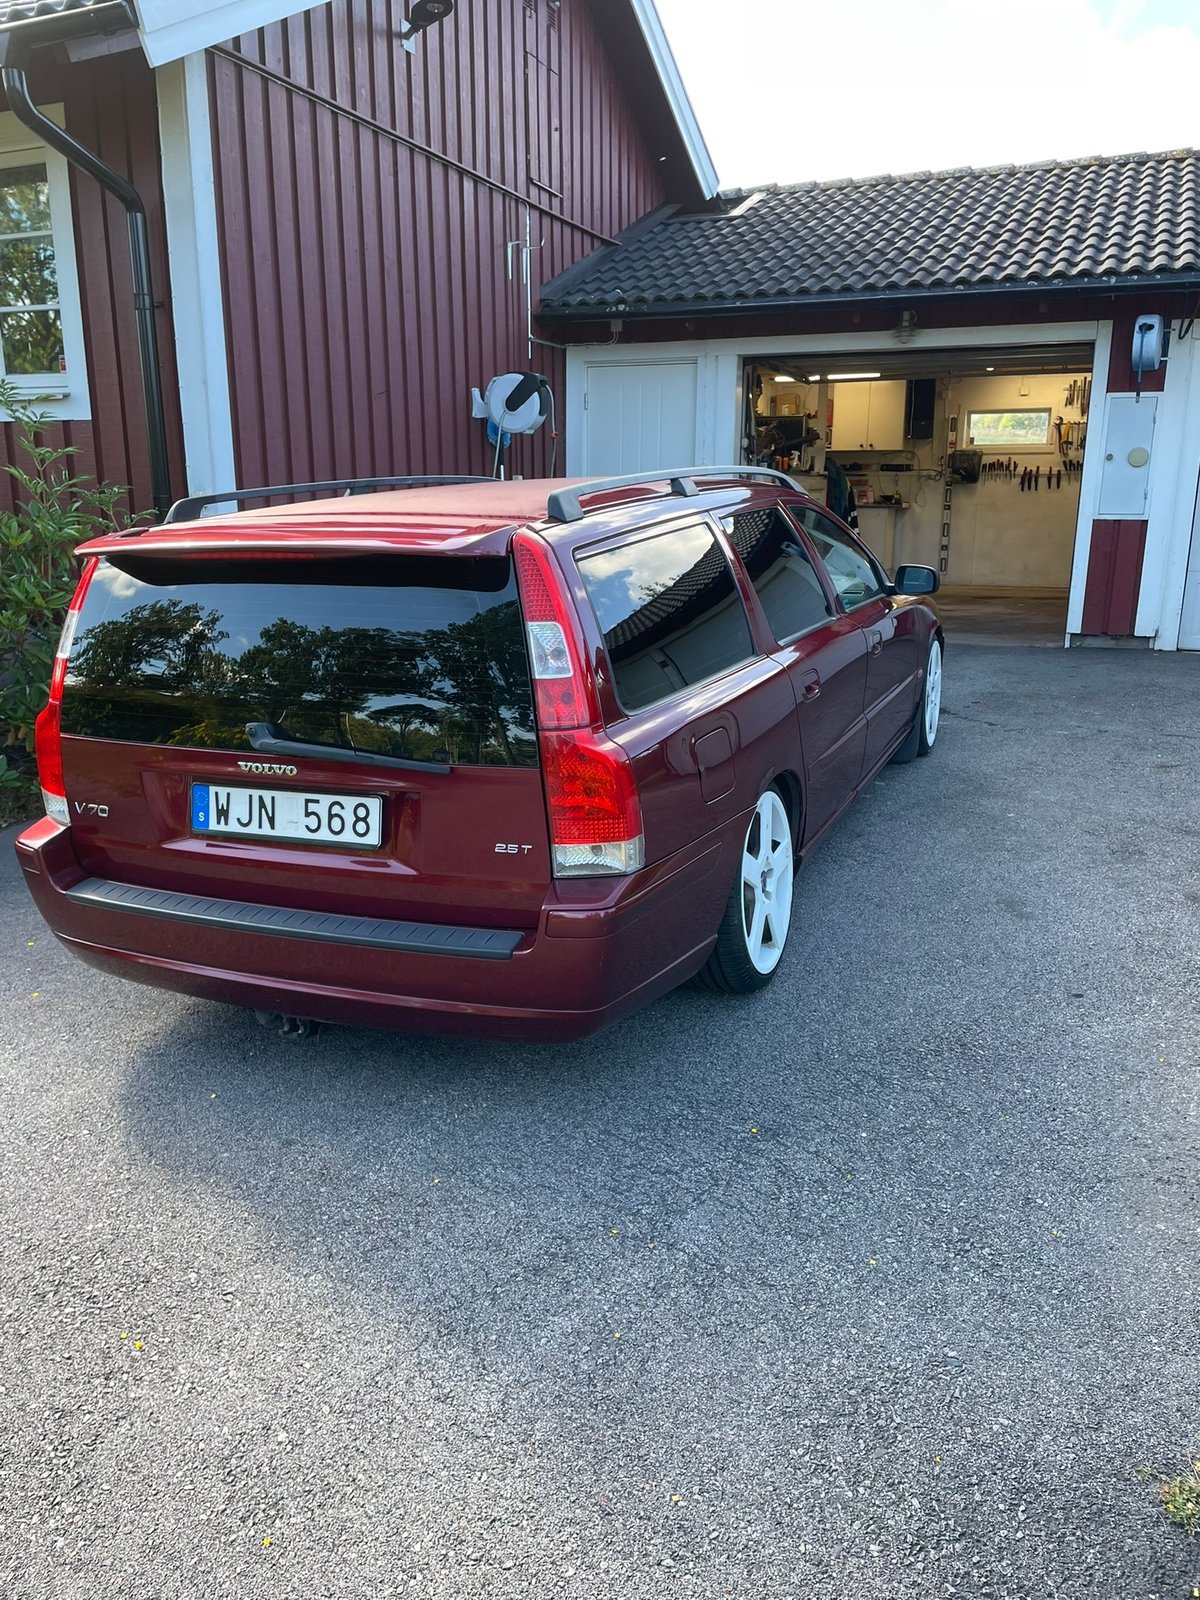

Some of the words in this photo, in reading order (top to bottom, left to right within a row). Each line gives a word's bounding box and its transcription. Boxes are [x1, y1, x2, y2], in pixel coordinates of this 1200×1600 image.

[237, 761, 298, 776] VOLVO
[198, 811, 205, 822] S
[214, 791, 275, 830] WJN
[304, 798, 371, 838] 568
